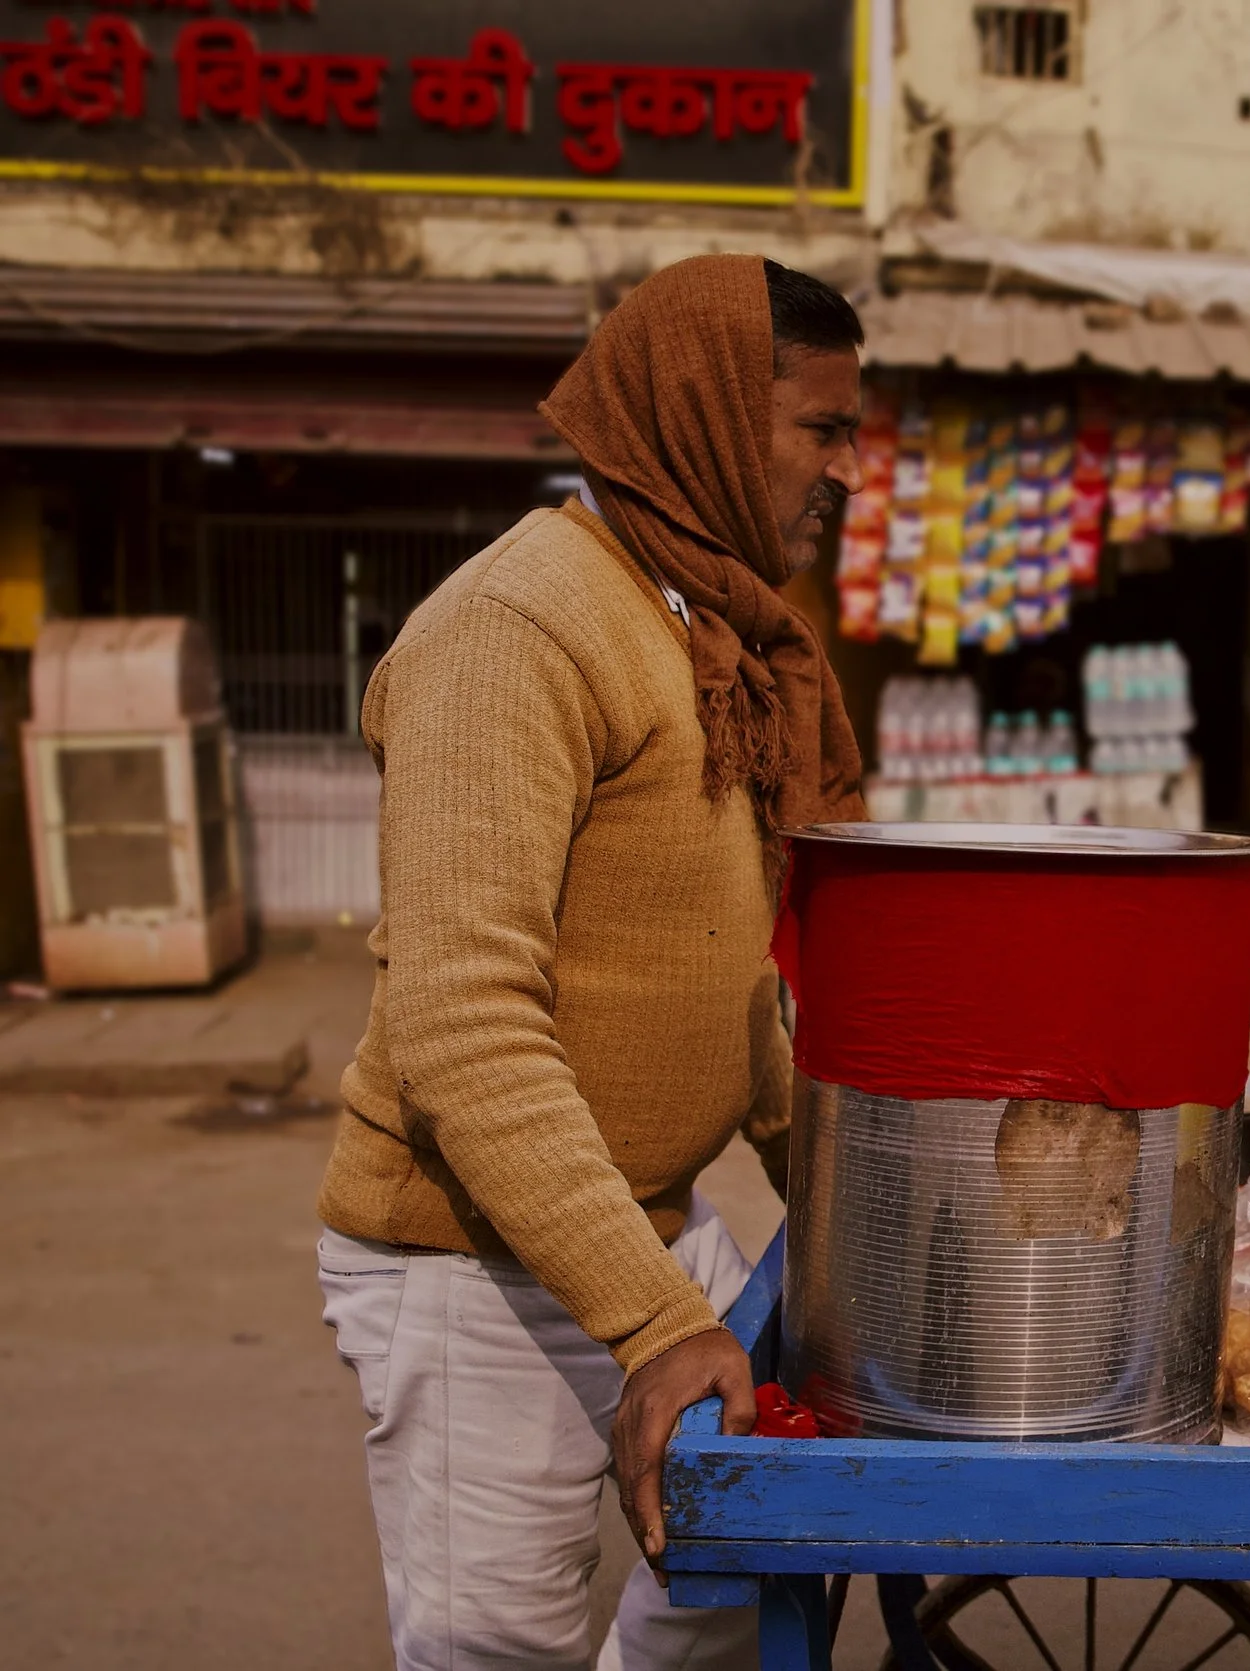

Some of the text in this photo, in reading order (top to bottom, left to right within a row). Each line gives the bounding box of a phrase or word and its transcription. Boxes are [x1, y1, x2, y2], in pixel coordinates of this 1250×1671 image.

[0, 14, 814, 175] ठंडी बियर की दुकान
